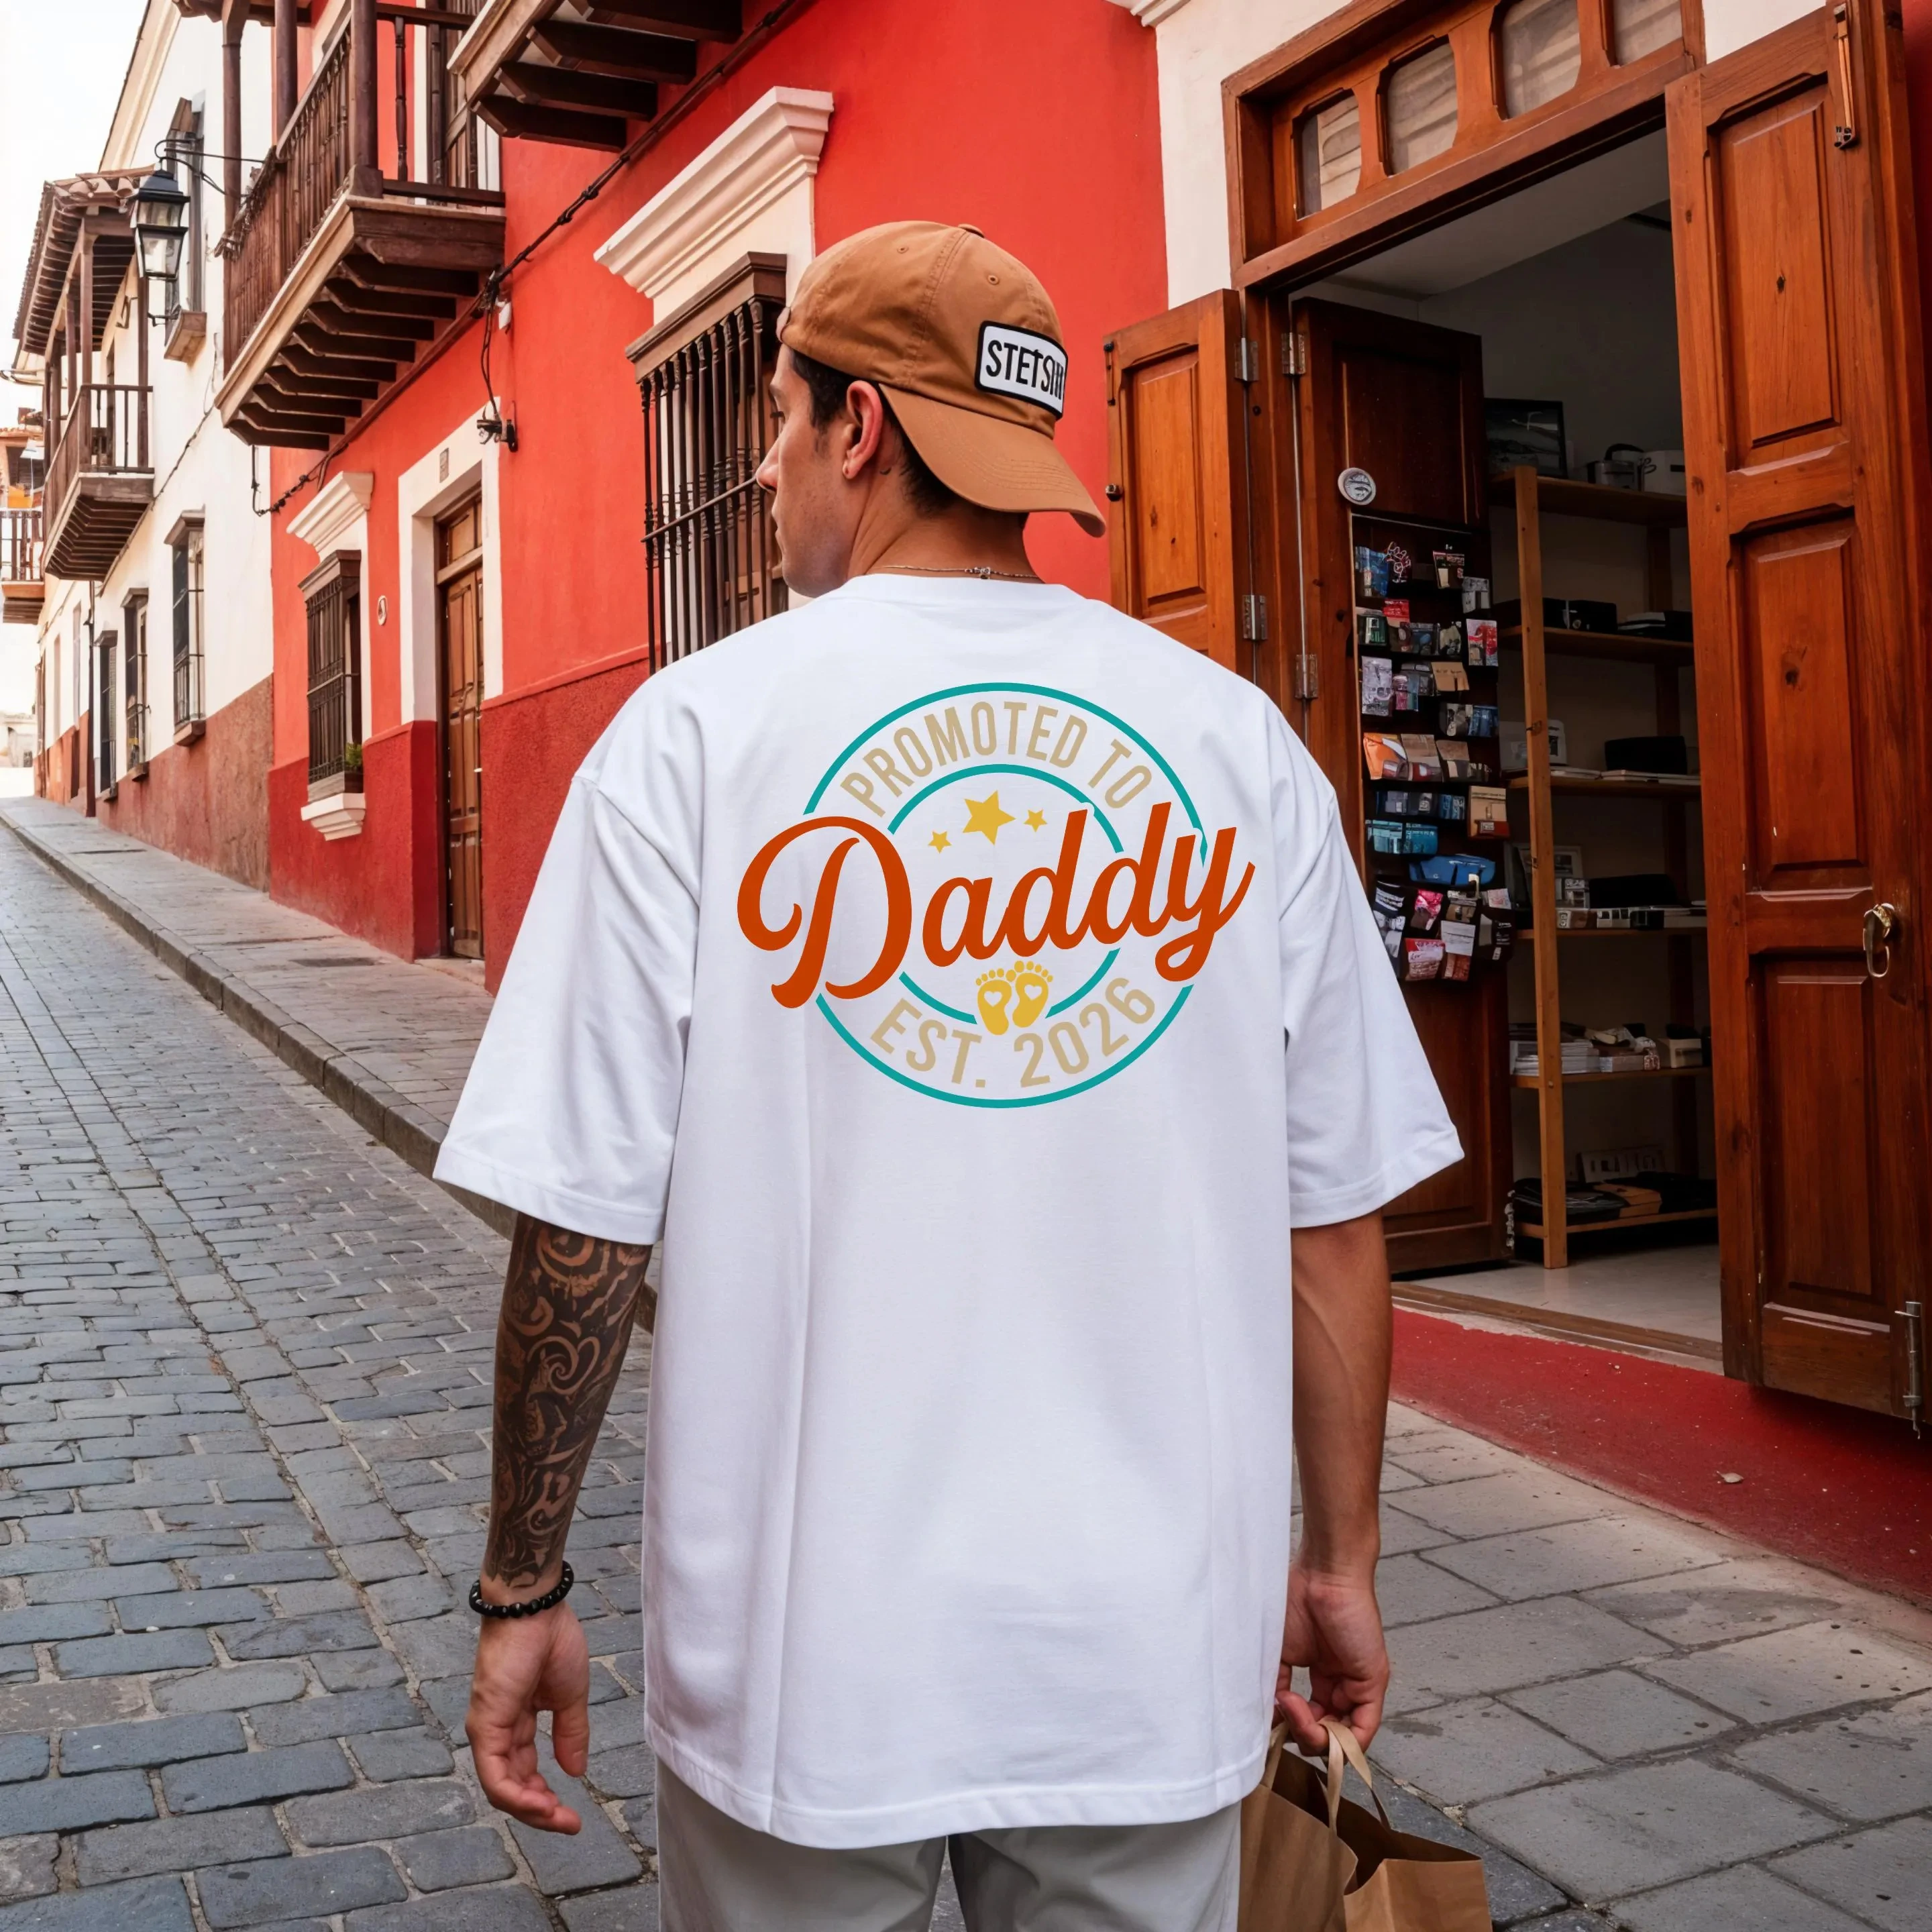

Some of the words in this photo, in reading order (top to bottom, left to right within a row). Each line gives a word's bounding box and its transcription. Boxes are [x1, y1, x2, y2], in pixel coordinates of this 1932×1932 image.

[840, 701, 1088, 817] PROMOTED
[1089, 739, 1152, 809] TO
[737, 802, 1256, 1009] Daddy
[870, 998, 986, 1088] EST.
[1014, 977, 1155, 1088] 2026
